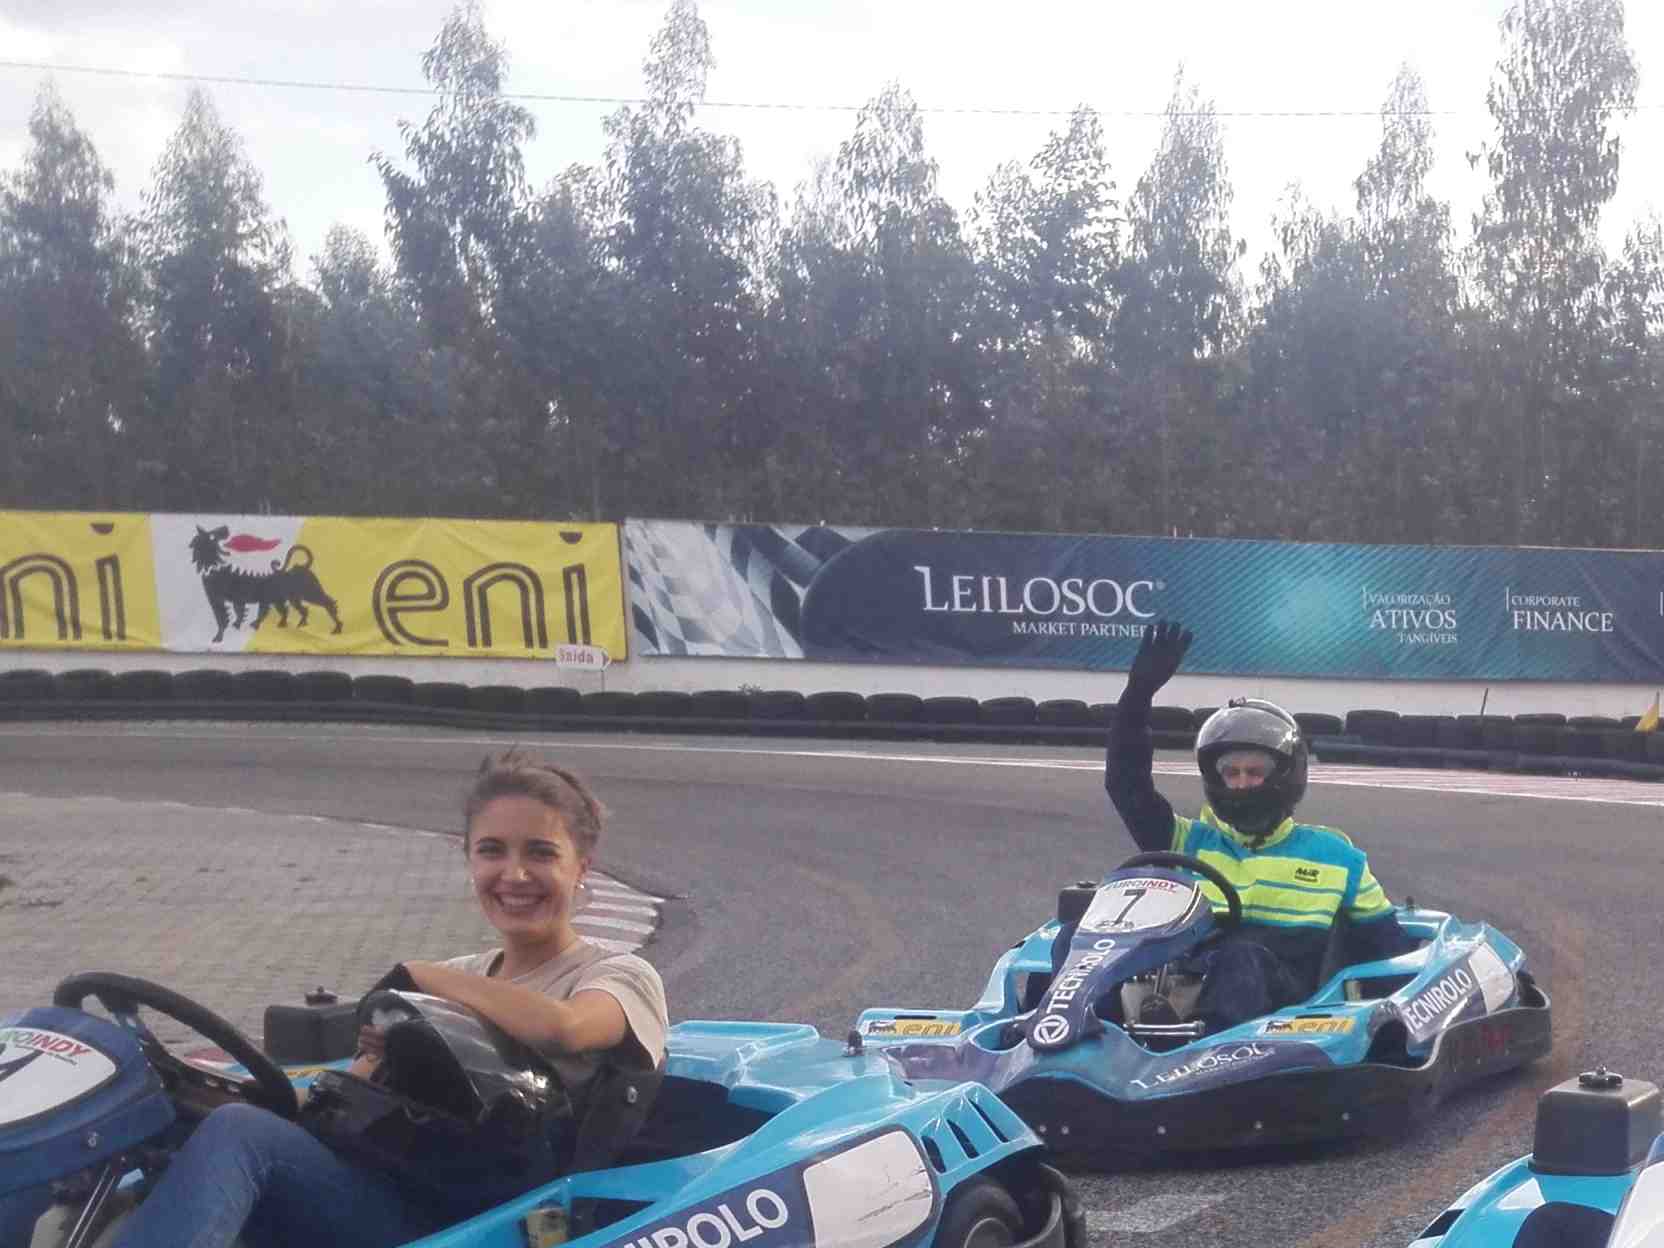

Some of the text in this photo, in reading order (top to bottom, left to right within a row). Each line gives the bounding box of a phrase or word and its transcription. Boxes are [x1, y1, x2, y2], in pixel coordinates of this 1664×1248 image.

[0, 523, 126, 641] ni
[373, 531, 592, 649] eni
[913, 565, 1157, 618] LEILOSOC
[1368, 608, 1458, 630] ATIVOS
[1511, 595, 1582, 608] CORPORATE
[1012, 620, 1077, 637] MARKET
[1512, 609, 1615, 633] FINANCE
[1114, 888, 1148, 925] 7
[1400, 968, 1473, 1035] TECNIROLO
